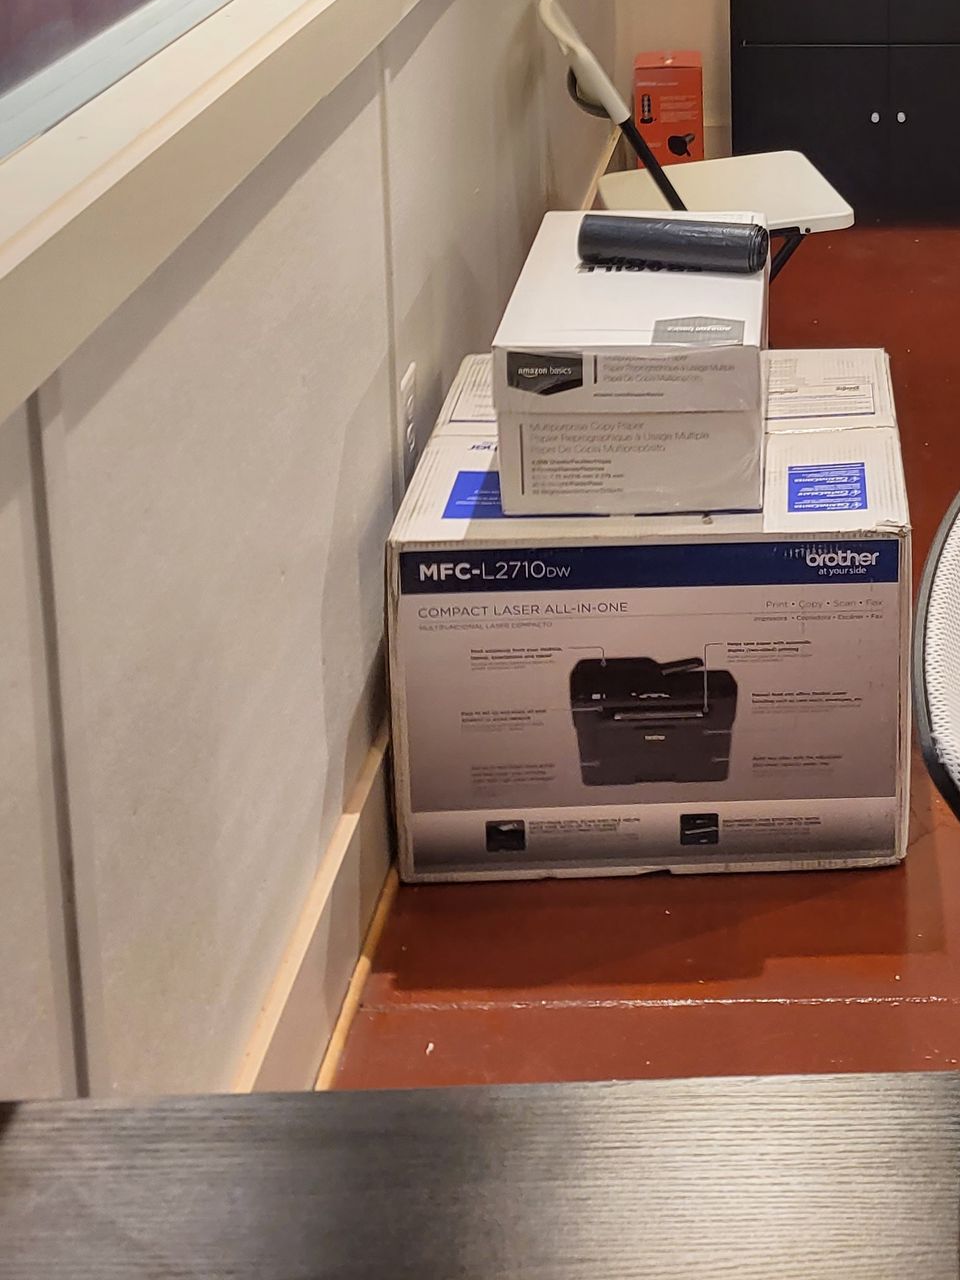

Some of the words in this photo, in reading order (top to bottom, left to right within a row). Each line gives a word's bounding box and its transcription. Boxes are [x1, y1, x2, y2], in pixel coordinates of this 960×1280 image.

[518, 367, 548, 377] amazon
[549, 366, 572, 376] basics
[806, 549, 880, 567] brother
[419, 561, 571, 581] MFC-L2710DW
[818, 567, 827, 575] at
[828, 568, 849, 577] your
[849, 566, 867, 575] side
[418, 605, 488, 619] COMPACT
[493, 604, 540, 616] LASER
[545, 602, 628, 615] ALL-IN-ONE
[766, 600, 789, 609] Print
[799, 599, 824, 610] Copy
[833, 599, 857, 608] Scan
[866, 598, 884, 607] Fax
